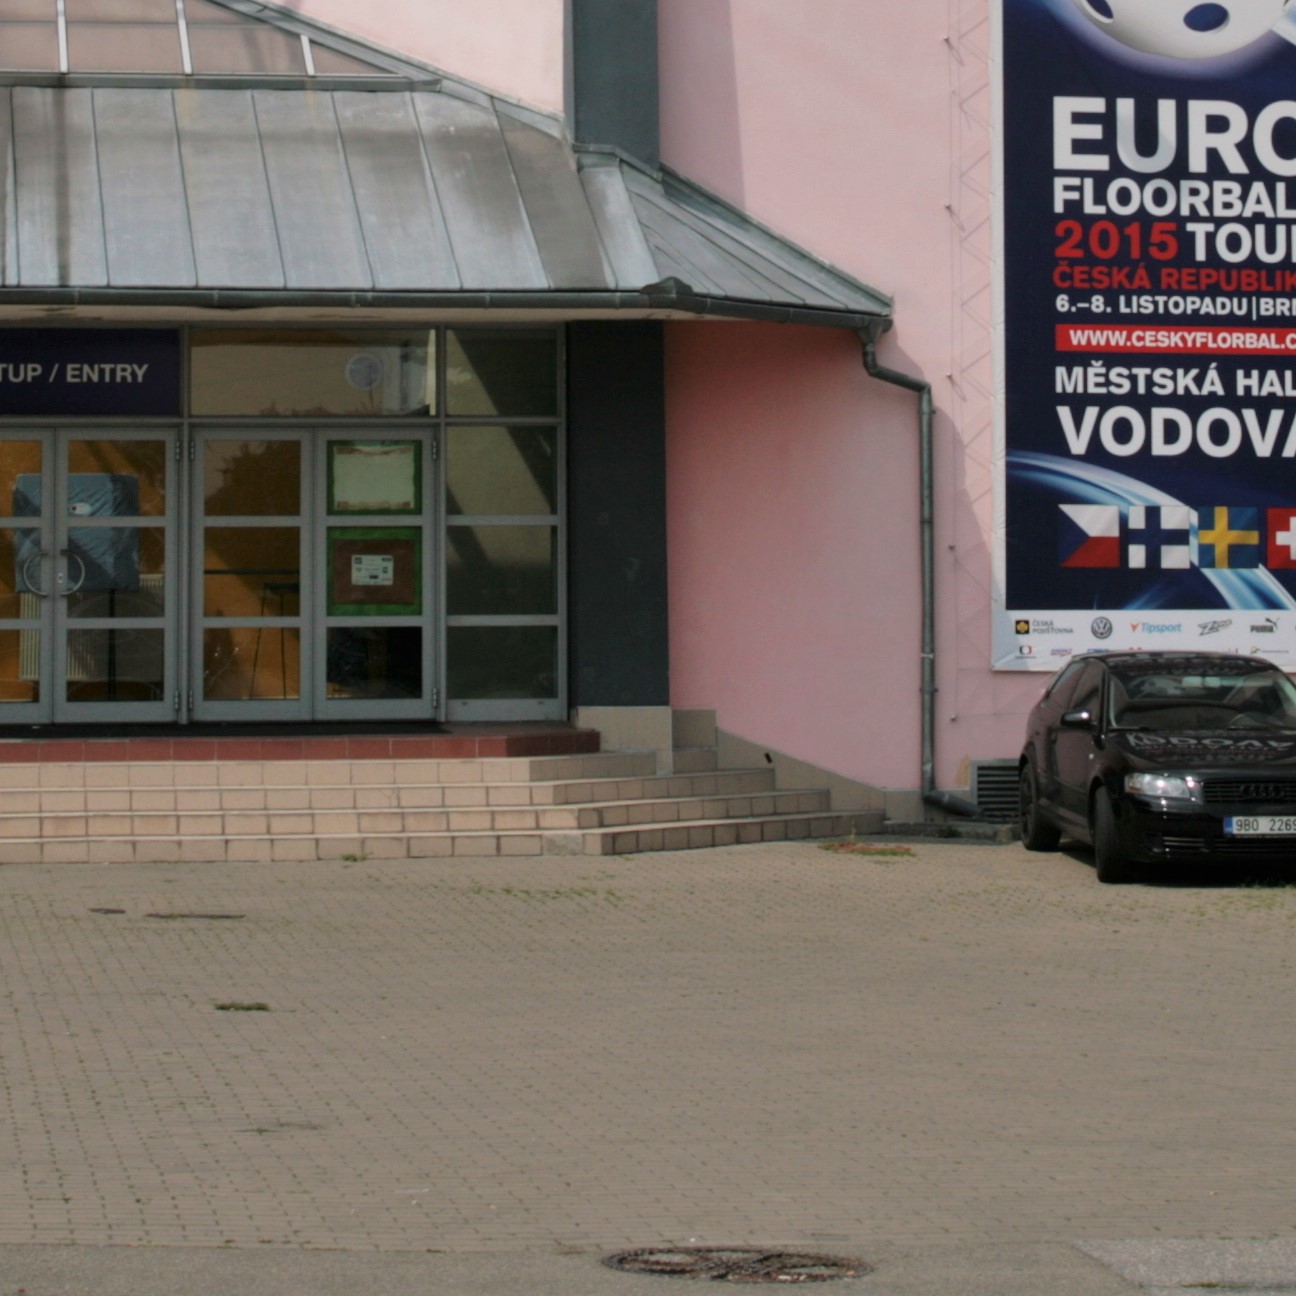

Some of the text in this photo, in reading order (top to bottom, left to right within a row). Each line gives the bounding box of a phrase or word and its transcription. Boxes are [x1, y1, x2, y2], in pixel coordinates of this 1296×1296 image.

[1054, 219, 1178, 261] 2015
[1052, 260, 1151, 291] ČESKÁ
[66, 363, 149, 383] ENTRY
[1055, 360, 1225, 397] MĚSTSKÁ
[1141, 622, 1182, 634] Tipsport
